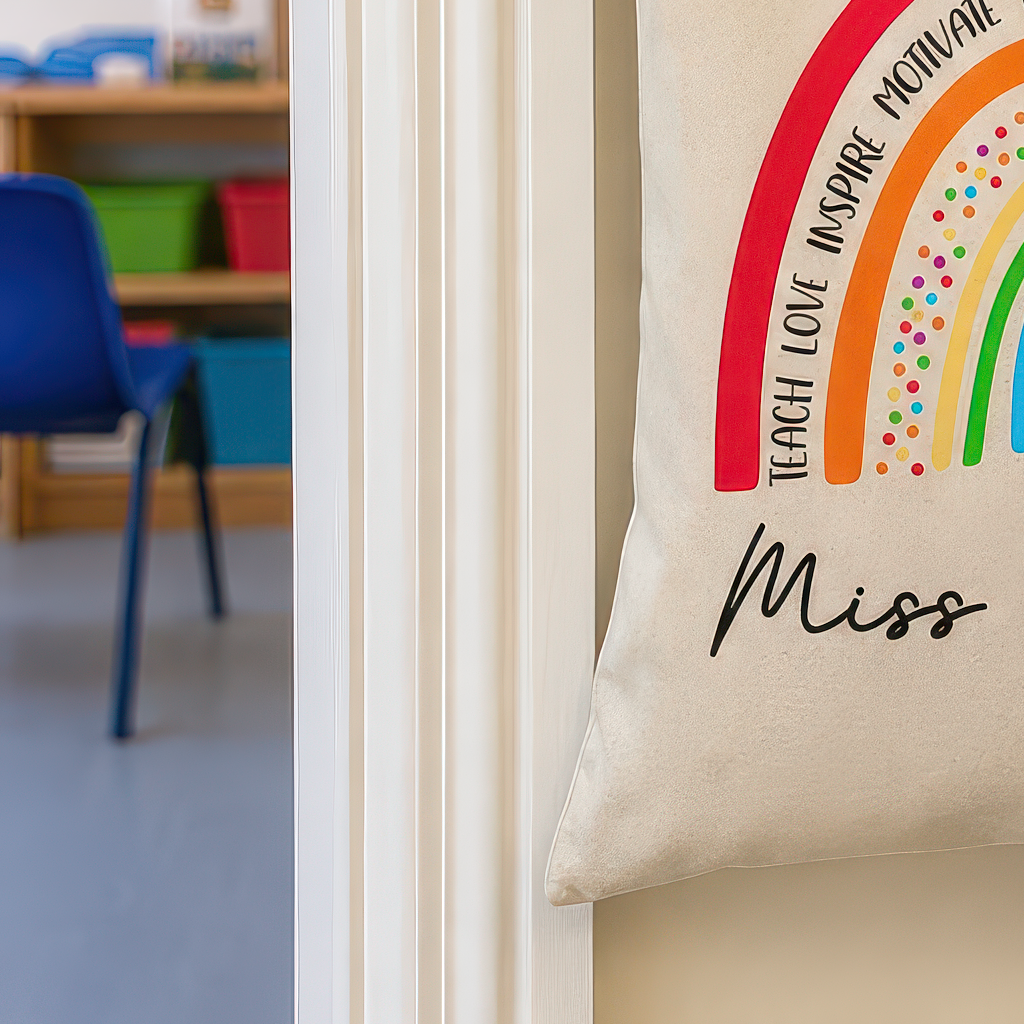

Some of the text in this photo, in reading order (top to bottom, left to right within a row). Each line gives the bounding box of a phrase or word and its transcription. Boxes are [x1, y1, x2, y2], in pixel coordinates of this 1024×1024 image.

[805, 124, 887, 256] INSPIRE
[779, 271, 830, 357] LOVE
[767, 375, 815, 488] TEACH
[709, 522, 988, 658] Miss
